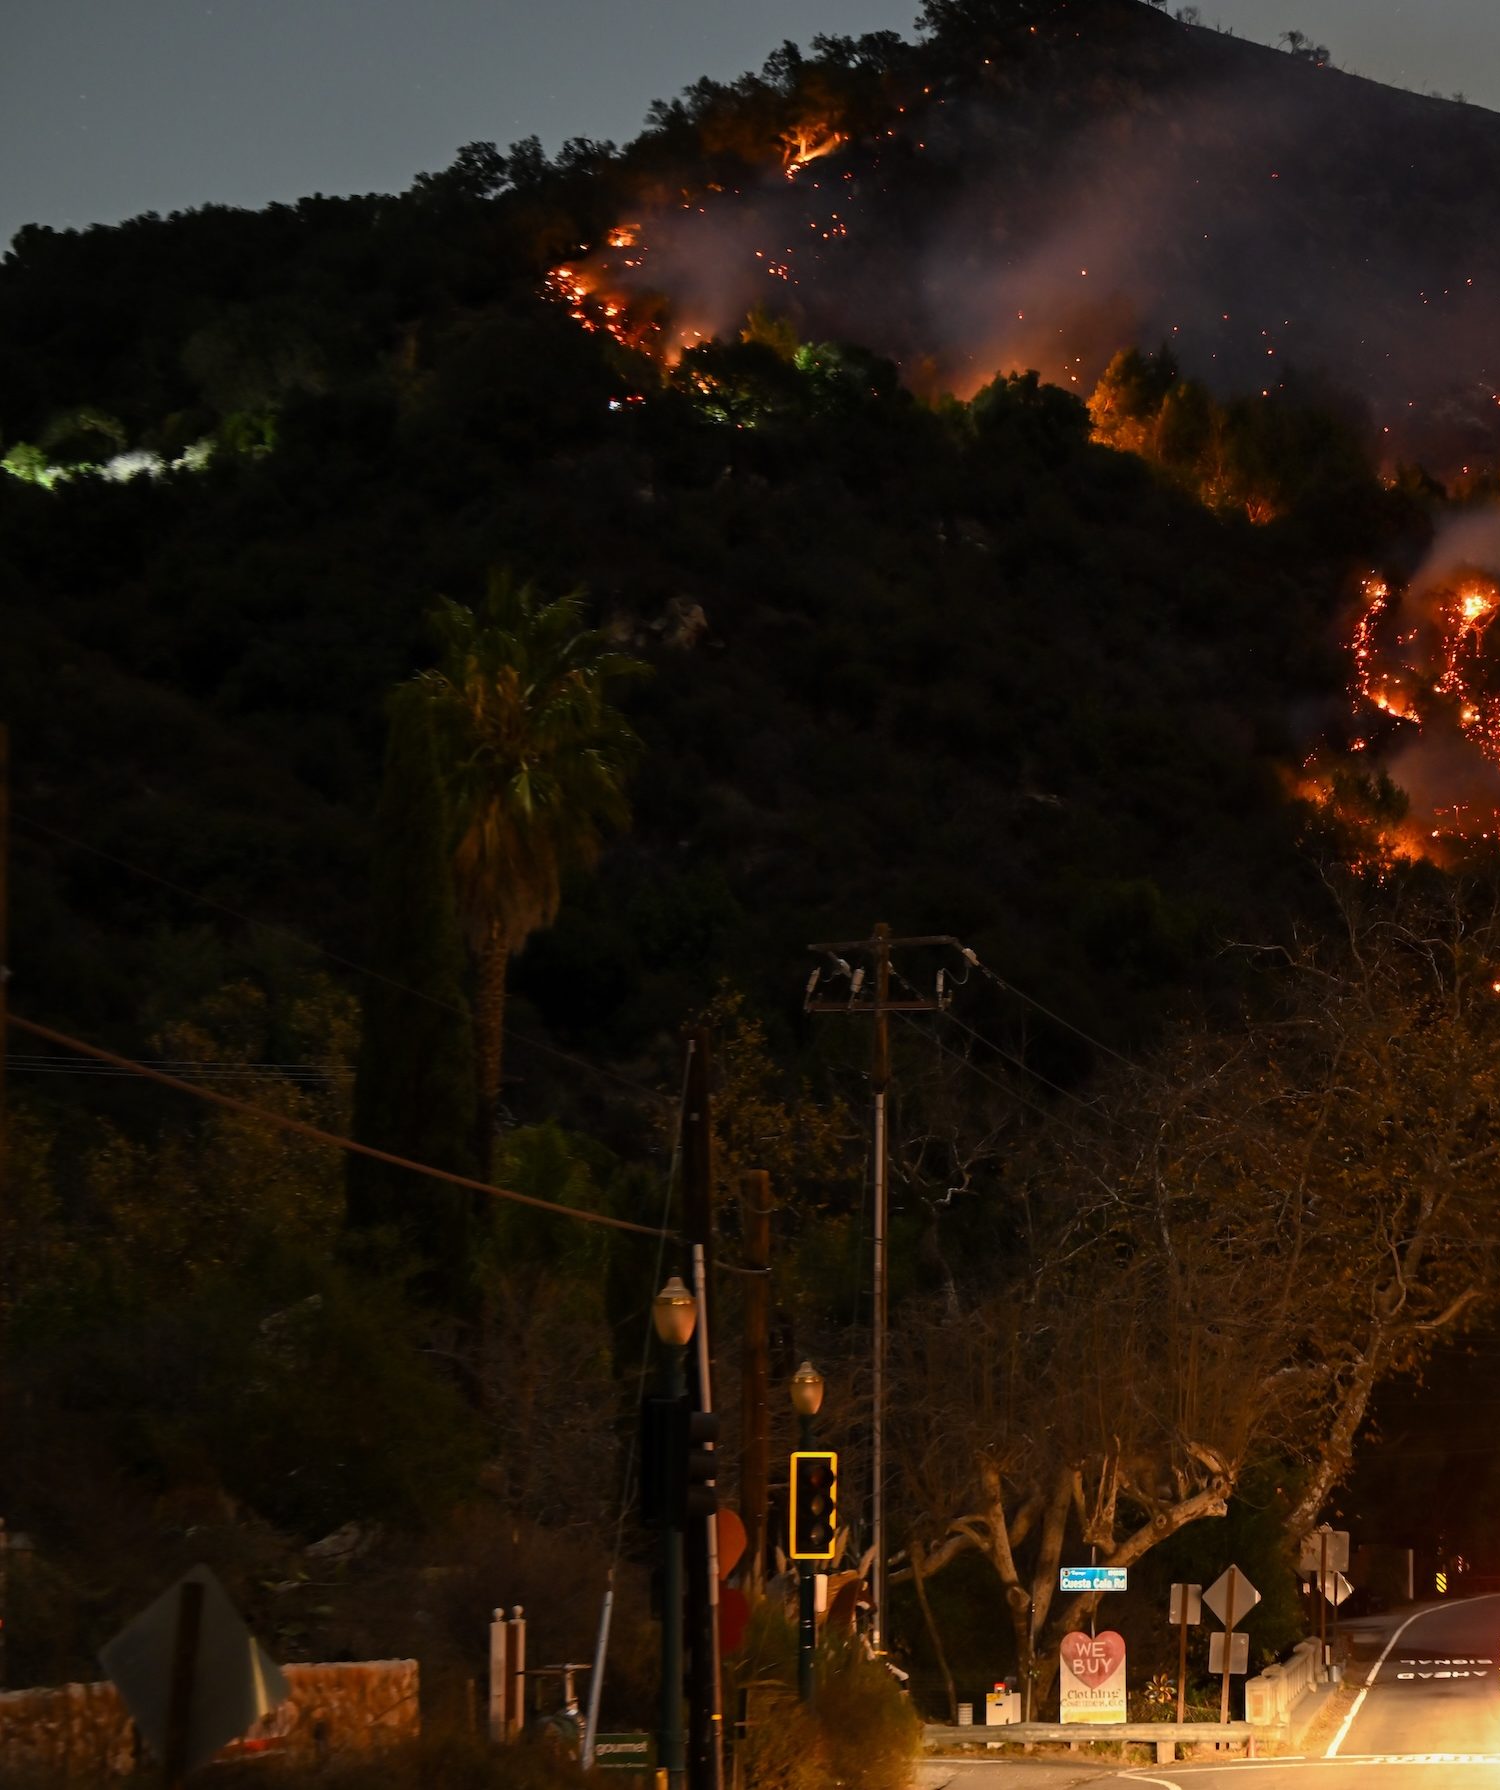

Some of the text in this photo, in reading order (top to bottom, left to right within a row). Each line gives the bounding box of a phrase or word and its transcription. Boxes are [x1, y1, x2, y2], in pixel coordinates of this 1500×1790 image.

[1062, 1578, 1092, 1589] Cuesta
[1076, 1642, 1106, 1657] WE
[1073, 1658, 1112, 1674] BUY
[1397, 1671, 1488, 1680] AHEAD
